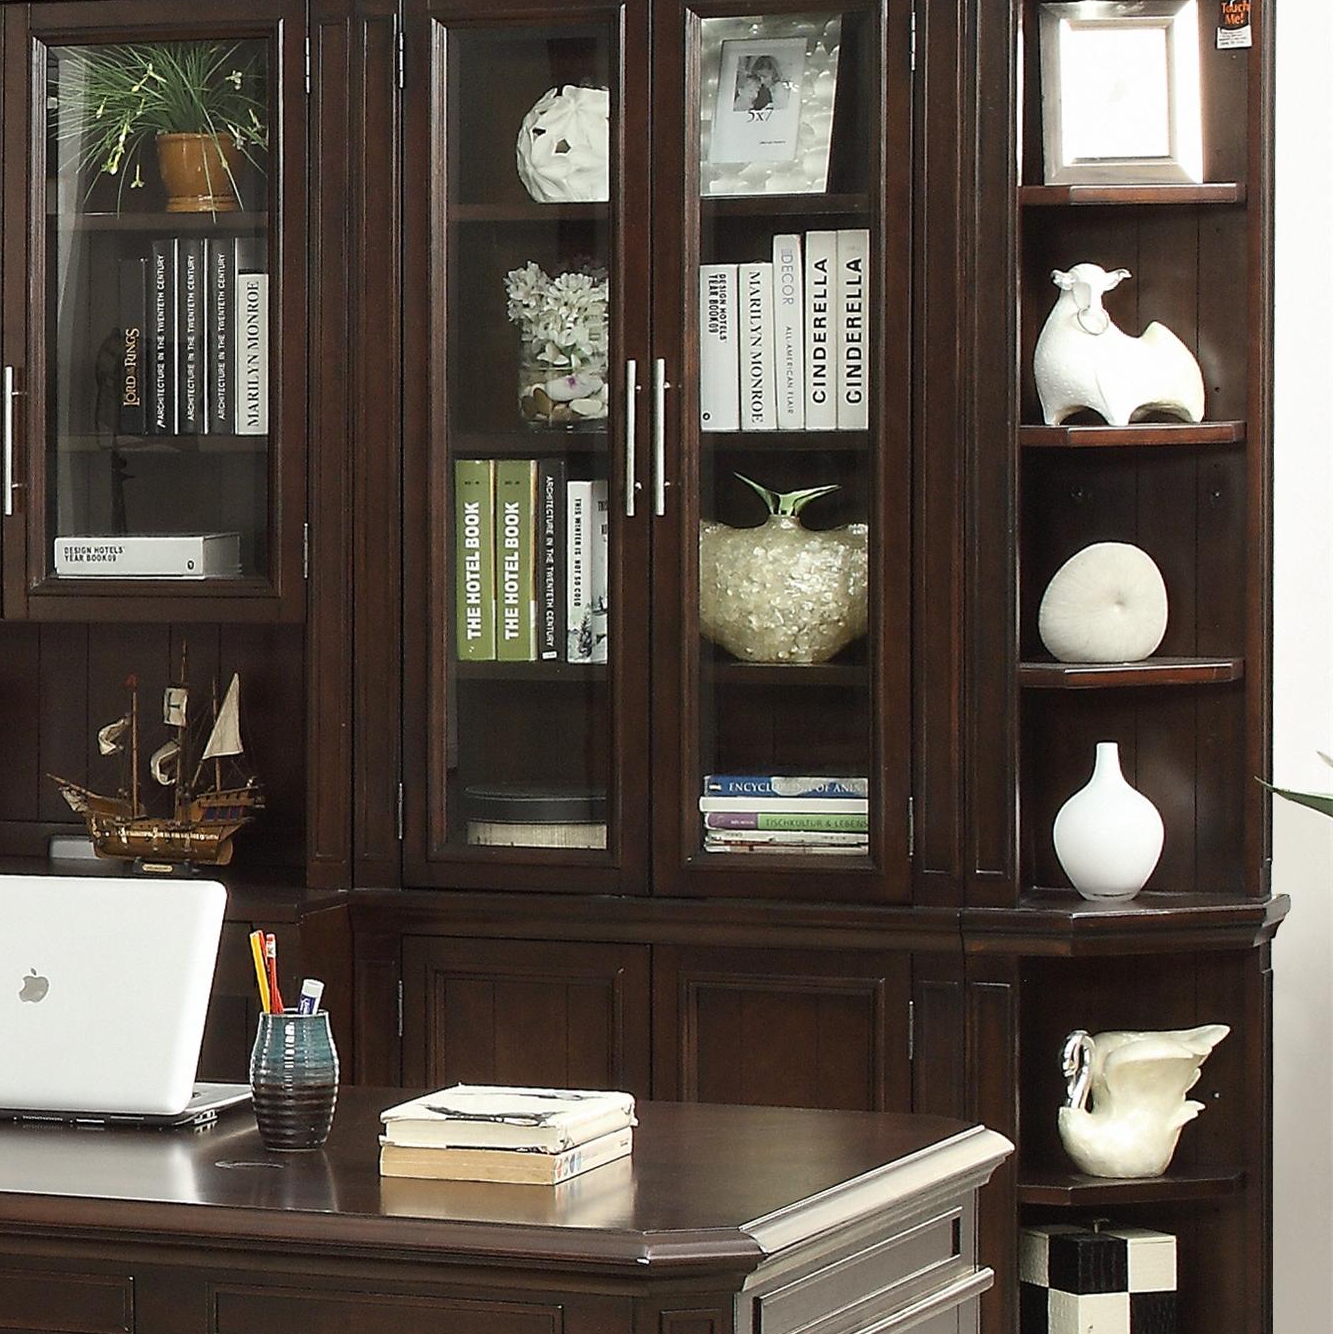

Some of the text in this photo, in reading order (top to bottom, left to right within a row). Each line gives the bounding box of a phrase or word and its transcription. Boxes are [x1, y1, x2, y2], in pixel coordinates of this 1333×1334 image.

[1221, 0, 1251, 14] Touch
[1225, 12, 1244, 25] Me!
[745, 107, 774, 123] 5x7
[124, 328, 140, 367] RINGS
[247, 281, 260, 427] MARILYN MONROE
[709, 298, 719, 320] BOOK
[719, 274, 727, 341] DESIGN HOTELS
[749, 271, 764, 423] MARILYN MONROE
[812, 258, 828, 404] CINDERELLA
[846, 258, 862, 404] CINDERELLA
[464, 501, 482, 640] THE HOTEL BOOK
[505, 501, 520, 640] THE HOTEL BOOK
